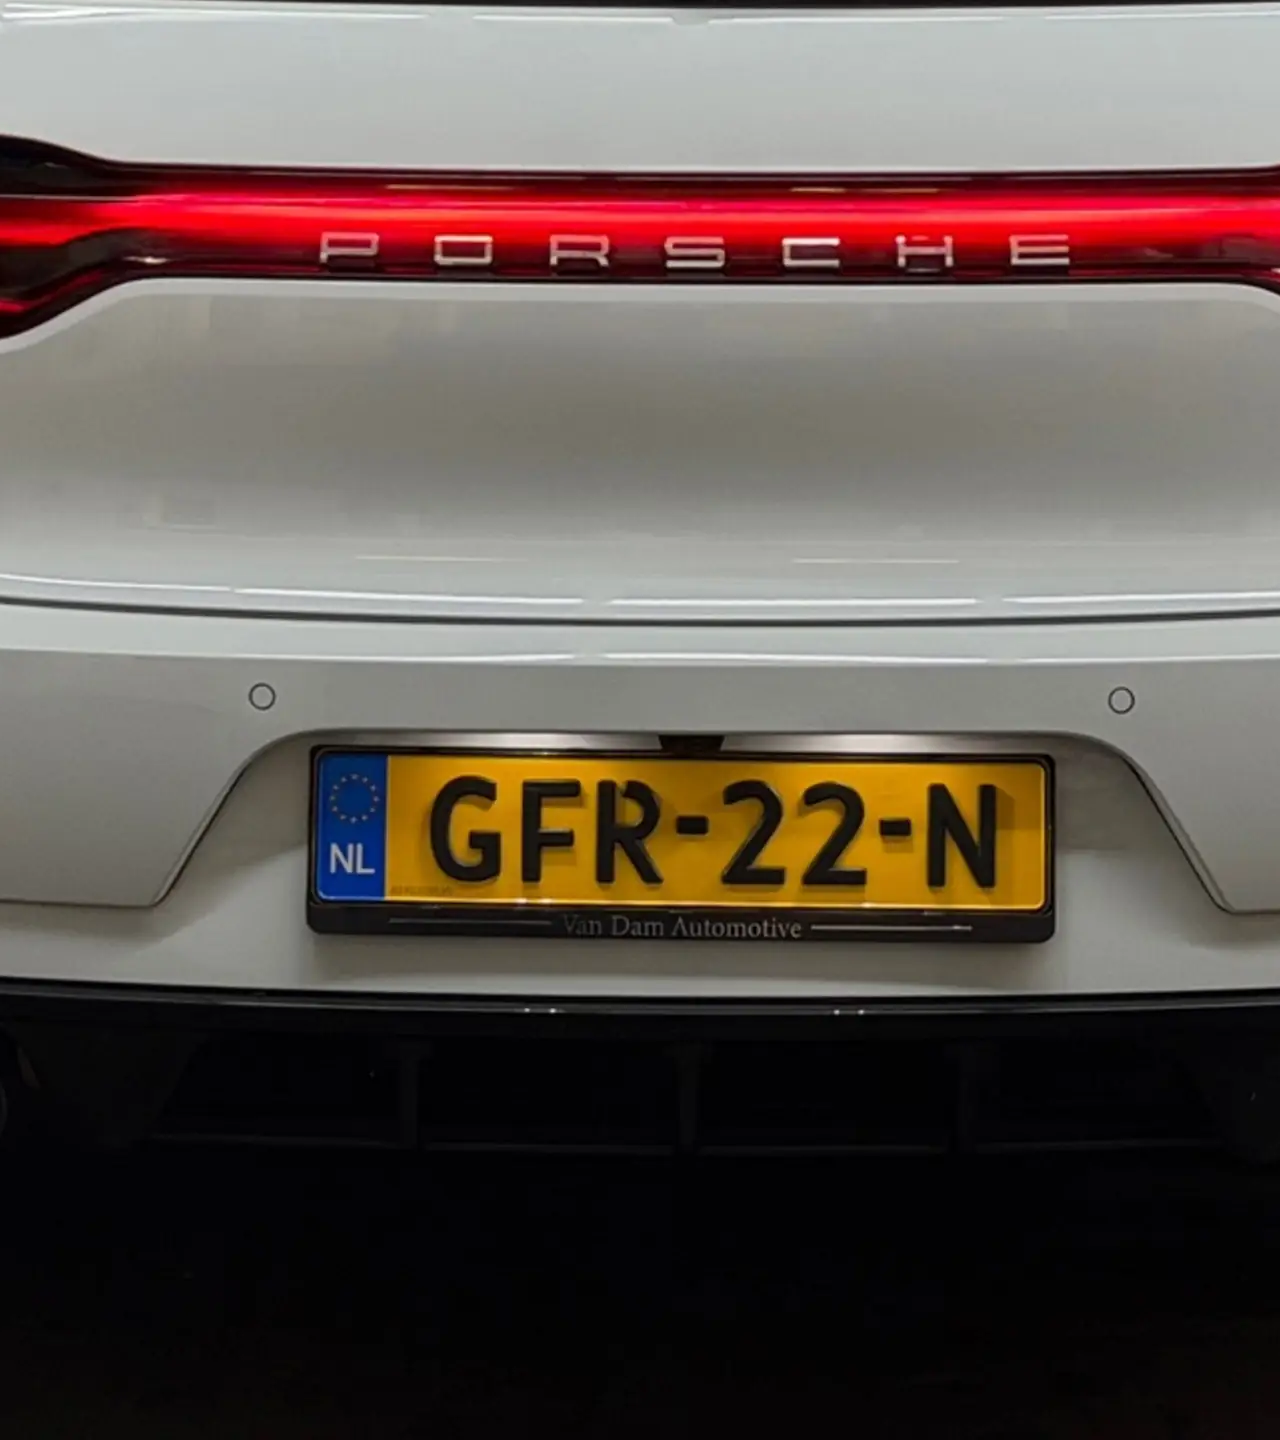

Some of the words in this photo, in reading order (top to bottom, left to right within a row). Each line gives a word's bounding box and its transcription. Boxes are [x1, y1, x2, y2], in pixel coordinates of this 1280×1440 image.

[320, 231, 1071, 269] PORSCHE
[428, 775, 998, 889] GFR-22-N
[330, 842, 376, 875] NL
[563, 914, 602, 936] Van
[611, 914, 665, 937] Dam
[671, 915, 803, 939] Automotive
